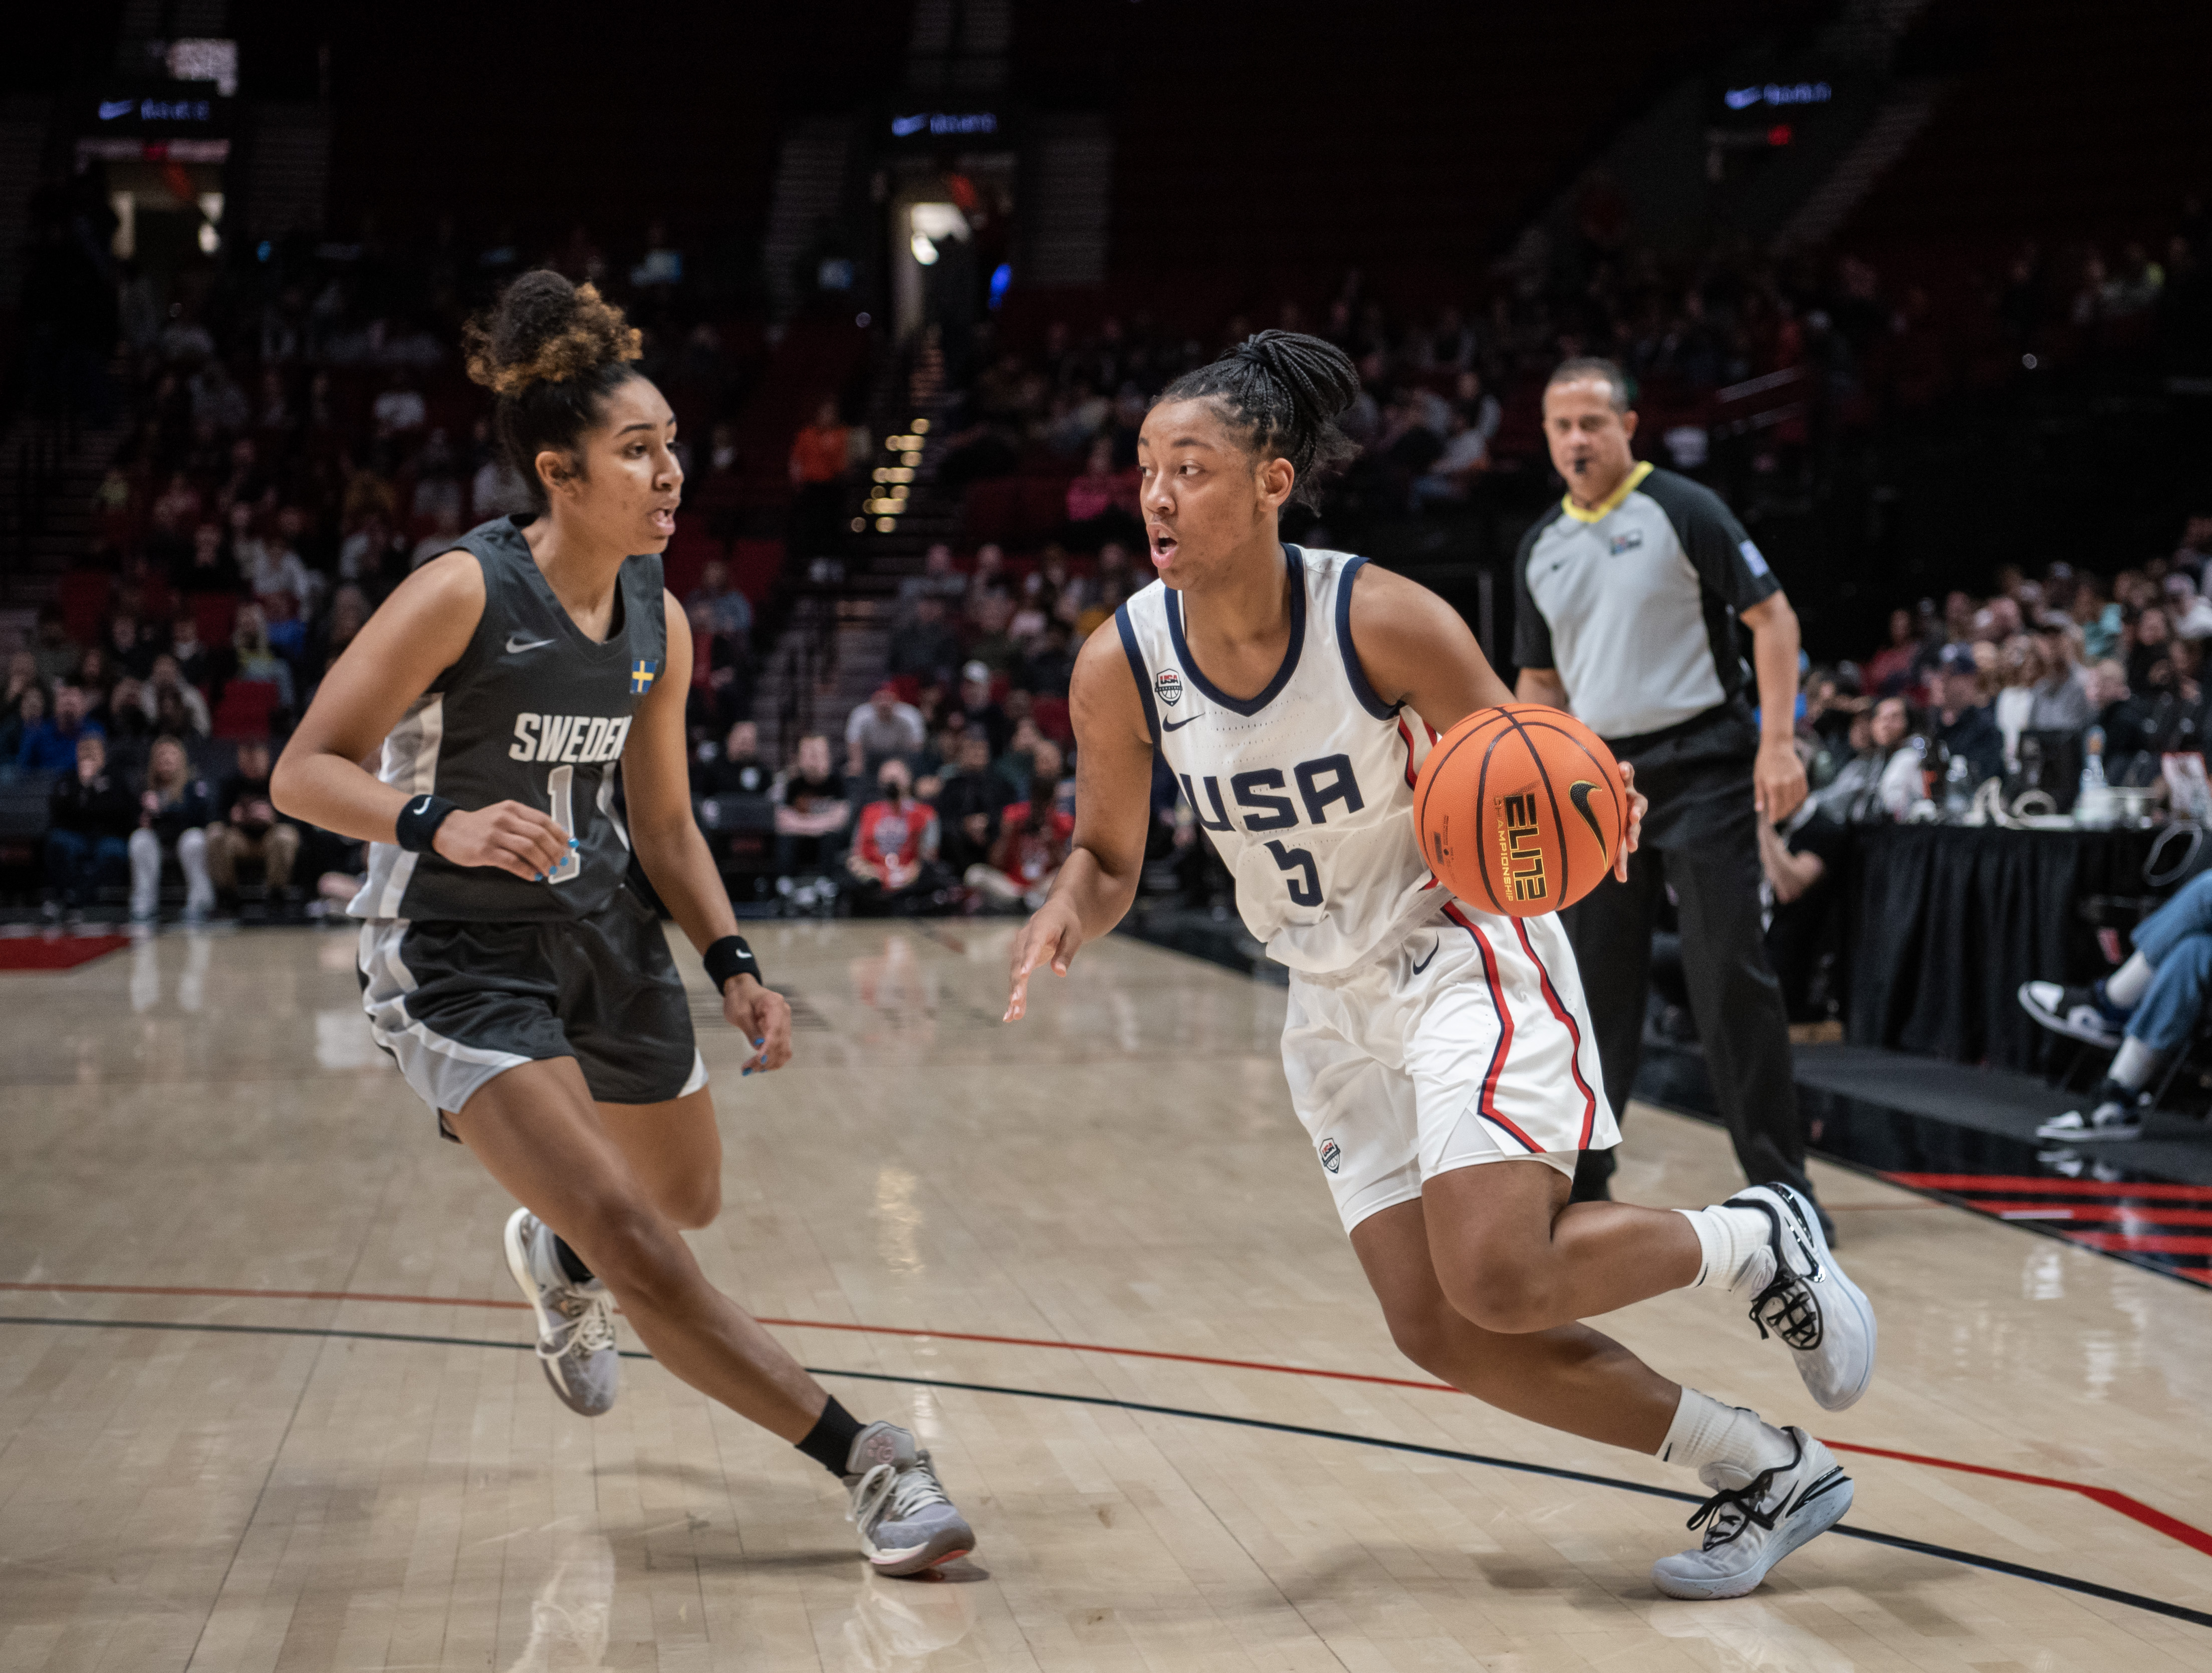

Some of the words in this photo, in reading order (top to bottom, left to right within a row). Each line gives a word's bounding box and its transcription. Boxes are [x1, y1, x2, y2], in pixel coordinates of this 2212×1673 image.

[1160, 675, 1178, 684] USA
[548, 765, 580, 884] 1
[1179, 754, 1365, 832] USA
[1264, 839, 1324, 907] 5
[1494, 797, 1514, 901] CHAMPIONSHIP
[1505, 794, 1548, 901] ELITE
